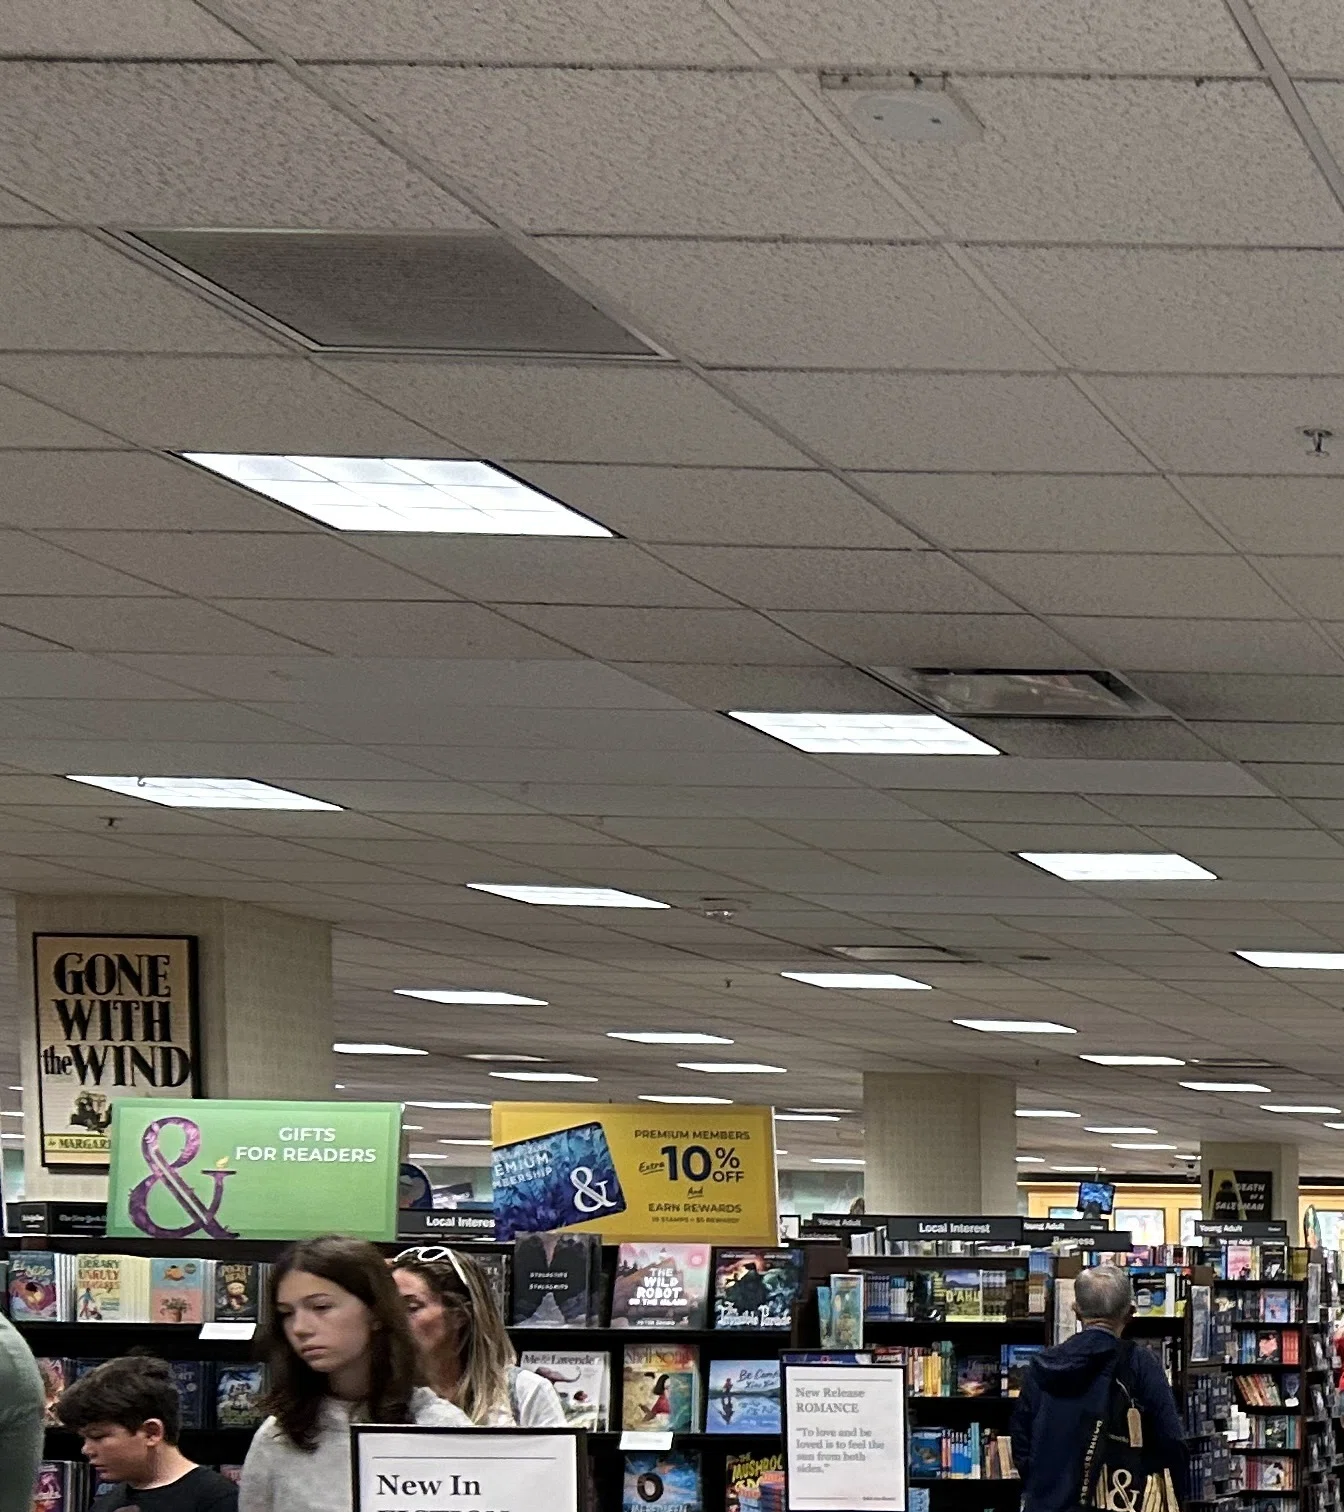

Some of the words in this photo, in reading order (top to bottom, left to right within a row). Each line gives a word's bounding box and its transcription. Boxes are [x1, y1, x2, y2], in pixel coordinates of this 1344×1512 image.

[53, 953, 171, 997] GONE
[52, 999, 172, 1042] WITH
[42, 1046, 73, 1077] the
[71, 1044, 191, 1087] WIND
[279, 1127, 335, 1143] GIFTS
[635, 1130, 689, 1140] PREMIUM
[693, 1130, 750, 1140] MEMBERS
[235, 1147, 278, 1162] FOR
[283, 1148, 376, 1163] READERS
[639, 1161, 664, 1174] Extra
[713, 1171, 744, 1183] OFF
[648, 1203, 680, 1213] EARN
[684, 1203, 742, 1214] REWARDS
[919, 1222, 944, 1234] Local
[949, 1222, 990, 1234] Interest
[650, 1268, 673, 1277] THE
[644, 1277, 678, 1287] WILD
[636, 1287, 683, 1299] ROBOT
[796, 1388, 819, 1398] New
[823, 1388, 865, 1398] Release
[796, 1403, 859, 1414] ROMANCE
[816, 1428, 836, 1438] love
[839, 1428, 857, 1438] and
[860, 1428, 872, 1438] be
[377, 1475, 442, 1496] New
[450, 1475, 481, 1496] In
